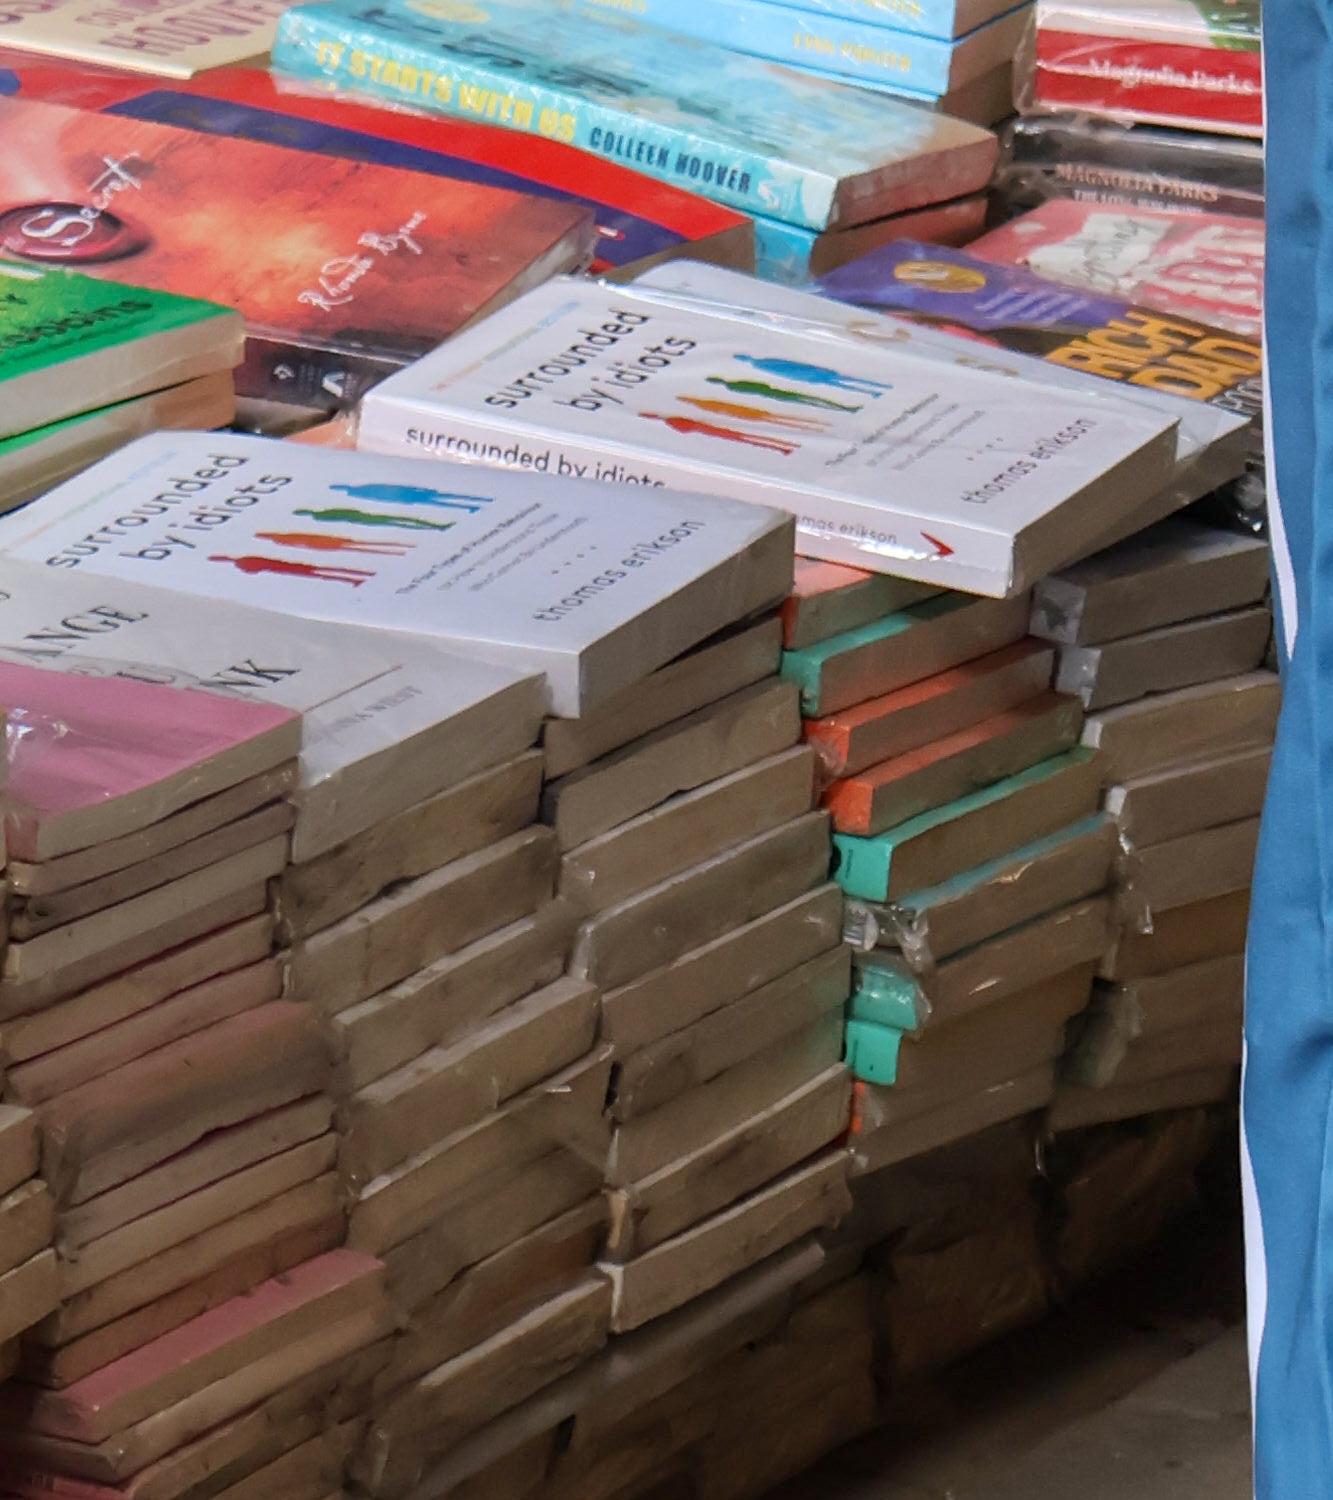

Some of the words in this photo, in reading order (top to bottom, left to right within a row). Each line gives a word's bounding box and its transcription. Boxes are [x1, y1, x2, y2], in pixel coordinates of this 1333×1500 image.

[315, 39, 344, 69] IT
[348, 51, 452, 103] STARTS
[456, 83, 534, 131] WITH
[537, 107, 578, 143] US
[588, 126, 668, 169] COLLEEN
[674, 151, 751, 195] HOOVER
[1088, 57, 1189, 89] Magnolia
[1191, 70, 1262, 93] Parks
[20, 151, 142, 247] Secret
[485, 308, 650, 409] surrounded
[552, 387, 625, 413] by
[590, 335, 698, 389] idiots
[1045, 309, 1206, 379] RICH
[1128, 337, 1263, 400] DAD
[406, 425, 550, 473] surrounded
[46, 452, 250, 568] surrounded
[119, 533, 197, 562] by
[167, 473, 293, 531] idiots
[530, 565, 626, 623] thomas
[623, 518, 707, 571] erikson
